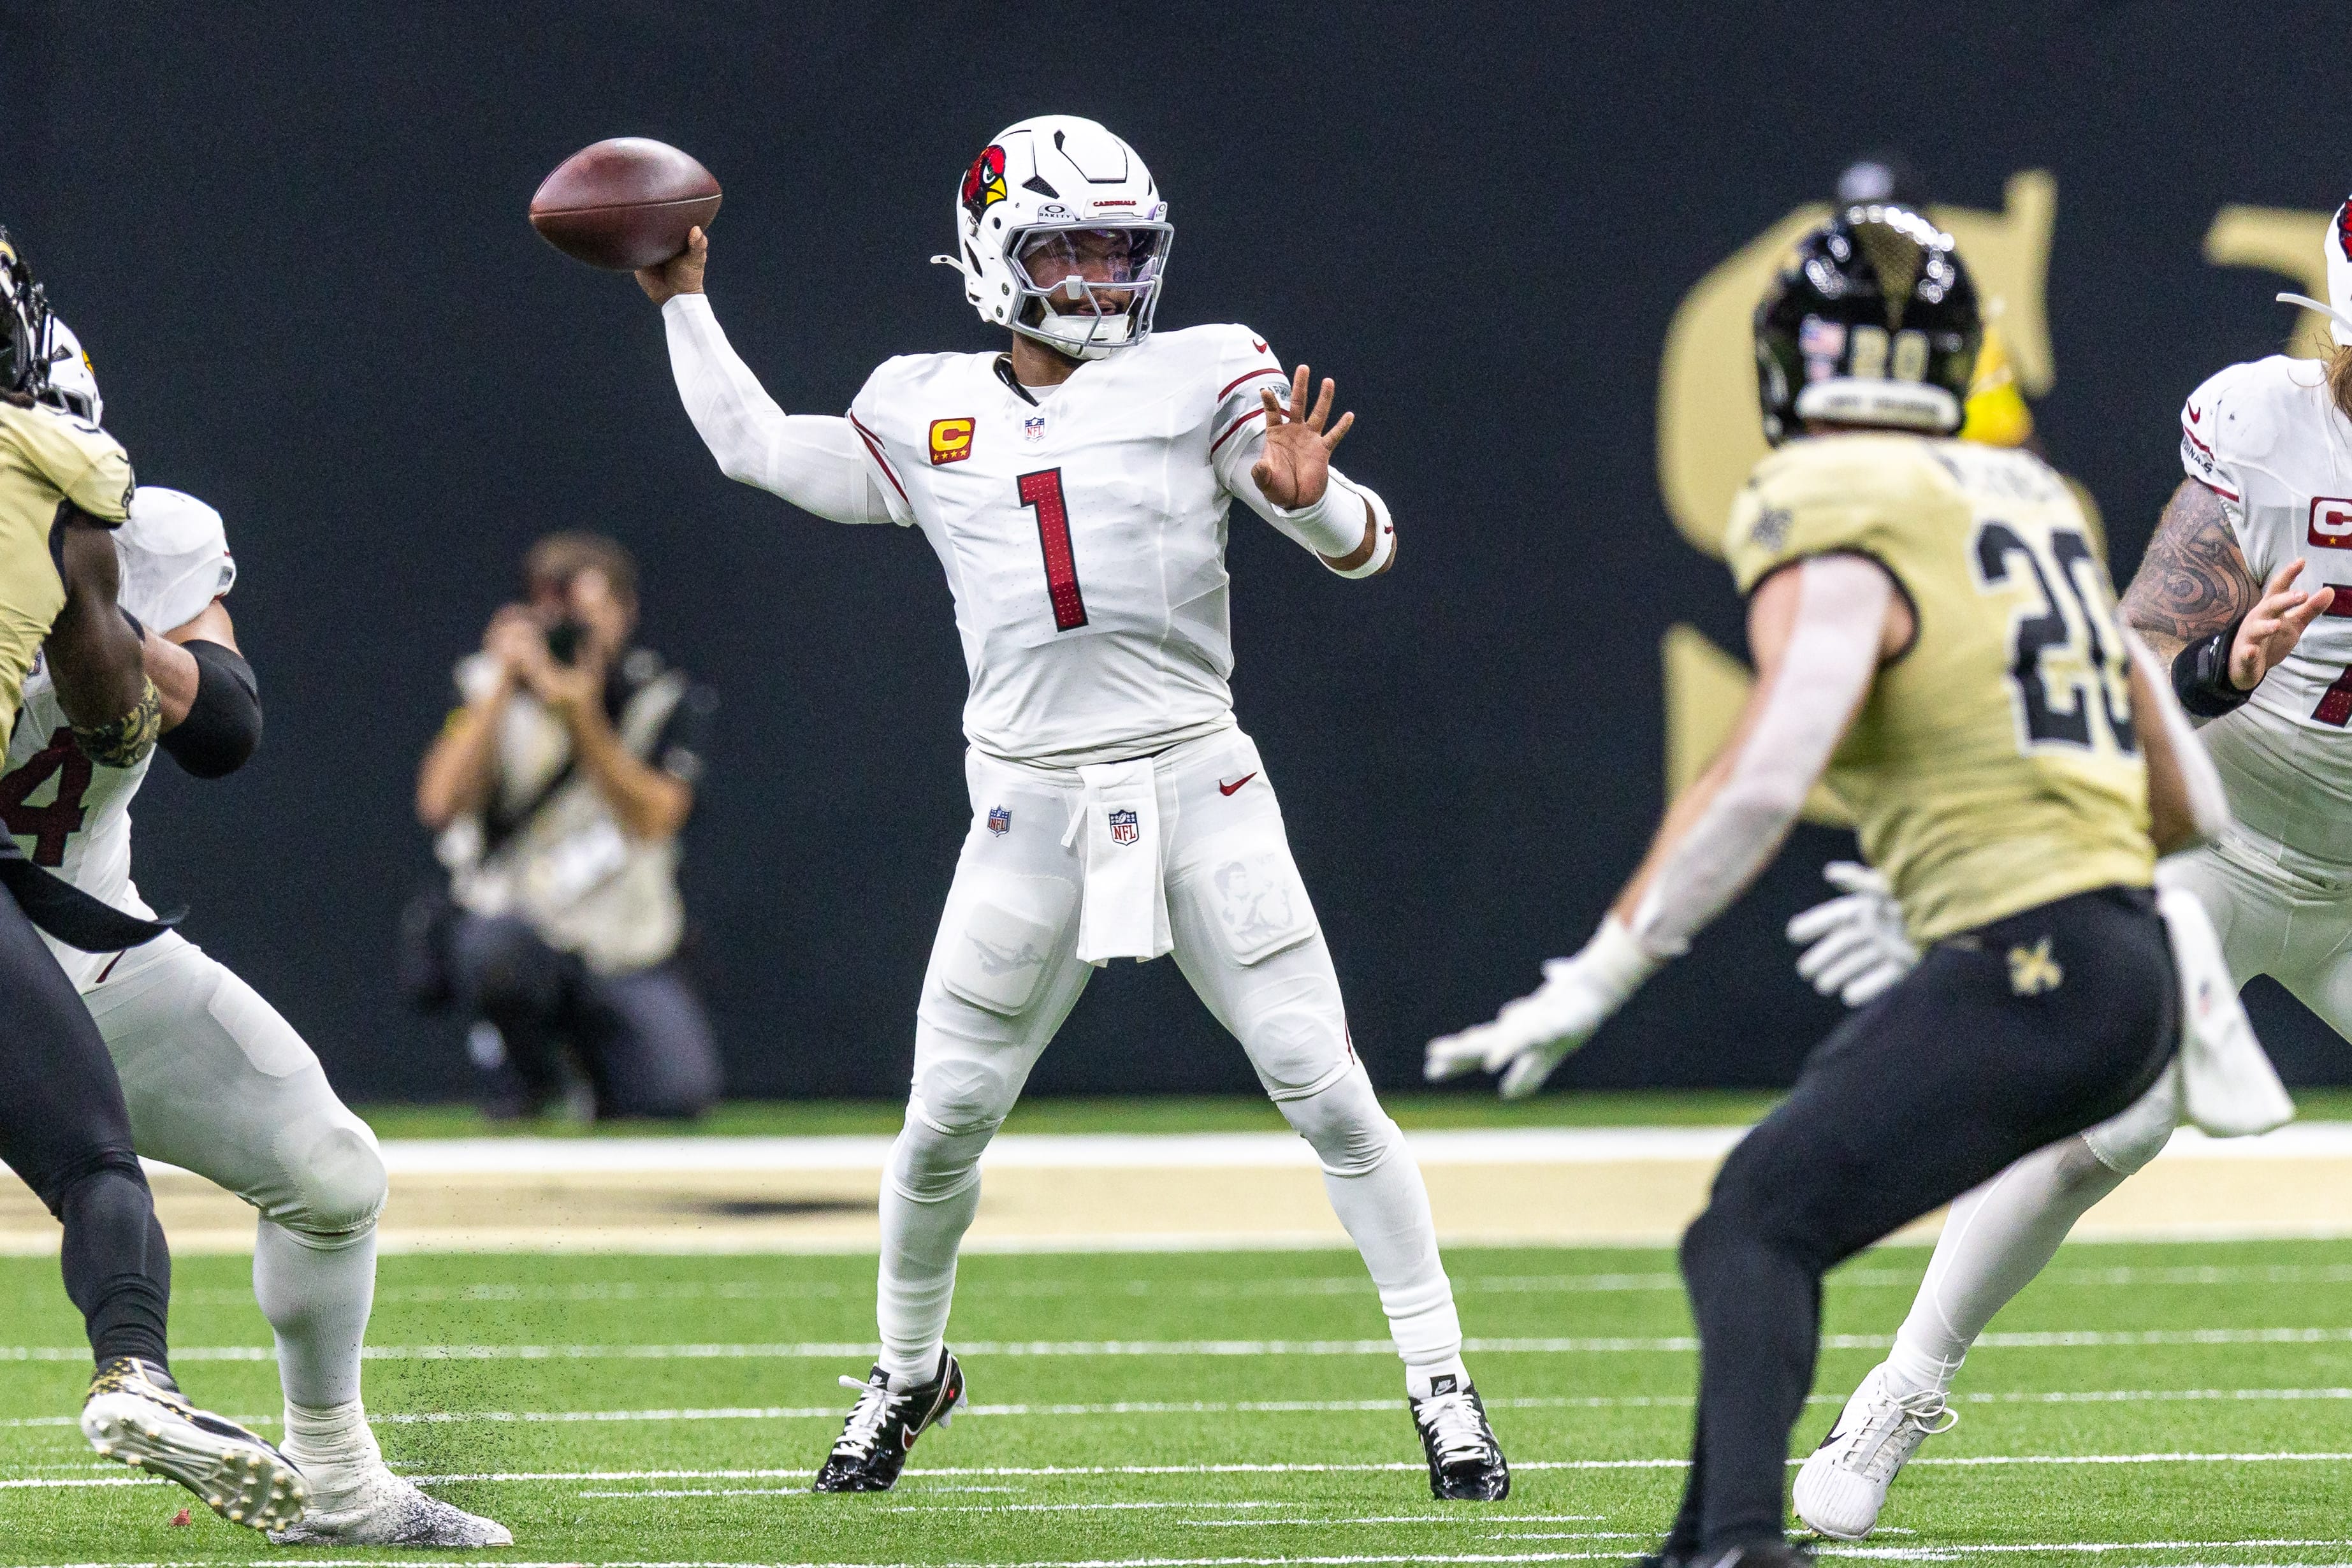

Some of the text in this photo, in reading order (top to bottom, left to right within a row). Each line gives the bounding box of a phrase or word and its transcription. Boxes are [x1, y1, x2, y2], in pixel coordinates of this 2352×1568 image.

[931, 419, 971, 452] C
[1027, 426, 1043, 437] NFL
[1016, 467, 1089, 633] 1
[1973, 519, 2140, 757] 20
[990, 818, 1006, 831] NFL
[1113, 824, 1136, 841] NFL
